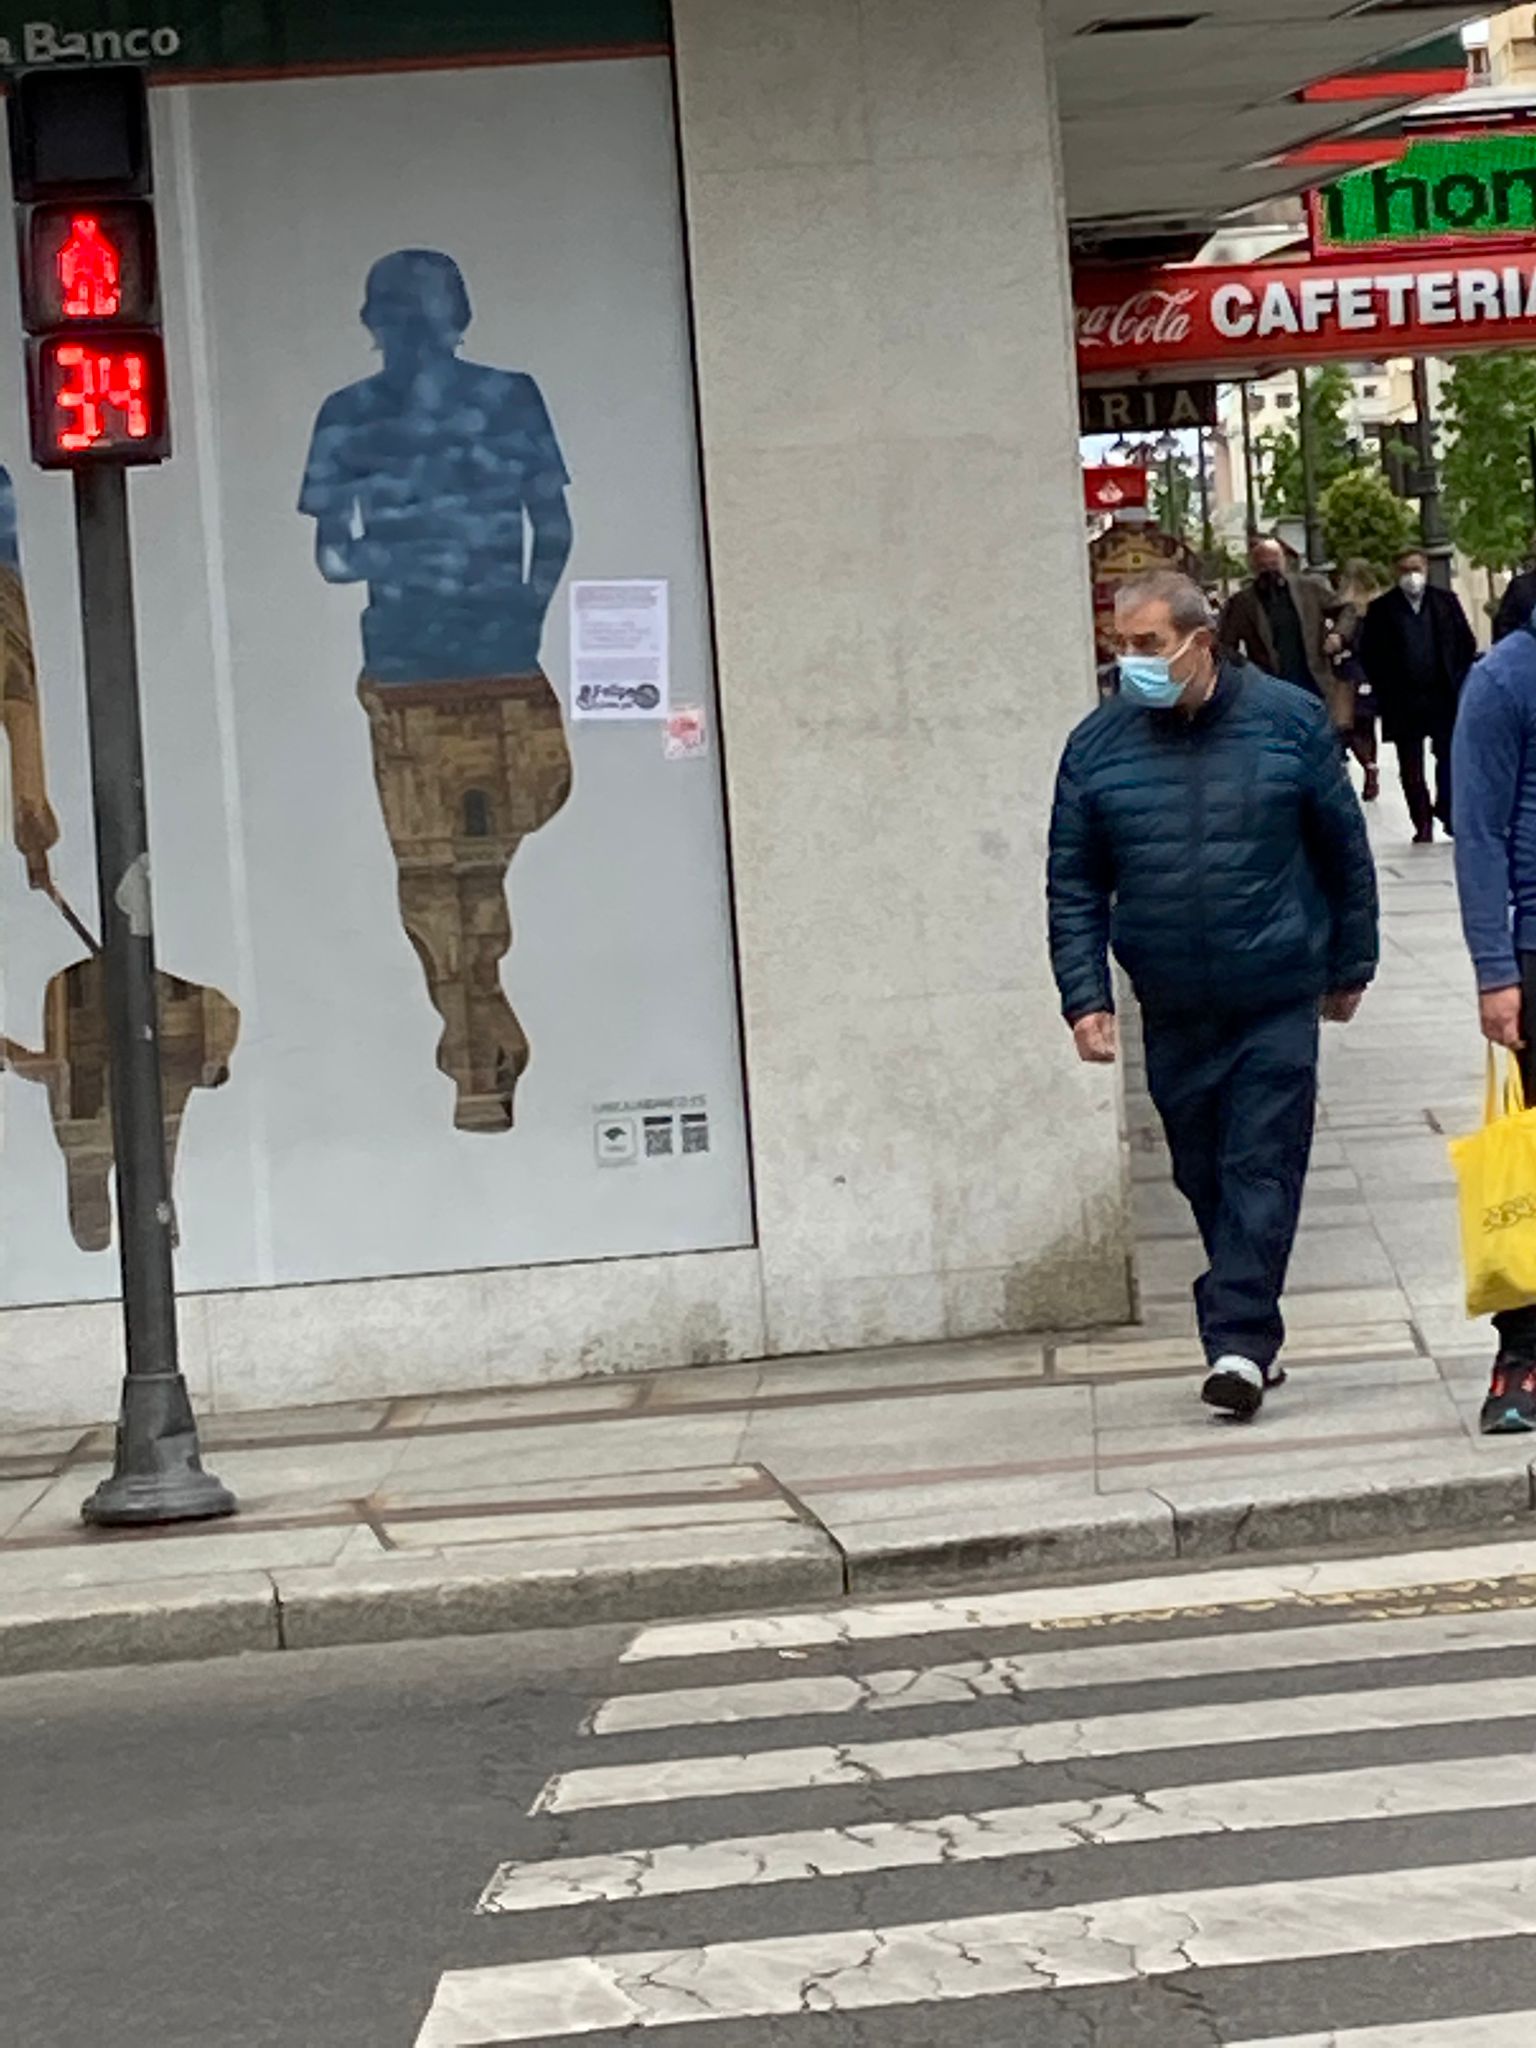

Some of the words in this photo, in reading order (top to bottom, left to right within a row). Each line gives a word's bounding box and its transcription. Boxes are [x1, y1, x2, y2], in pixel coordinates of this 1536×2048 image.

[23, 22, 180, 62] Banco
[1210, 266, 1536, 339] CAFETERI
[55, 345, 149, 451] 34
